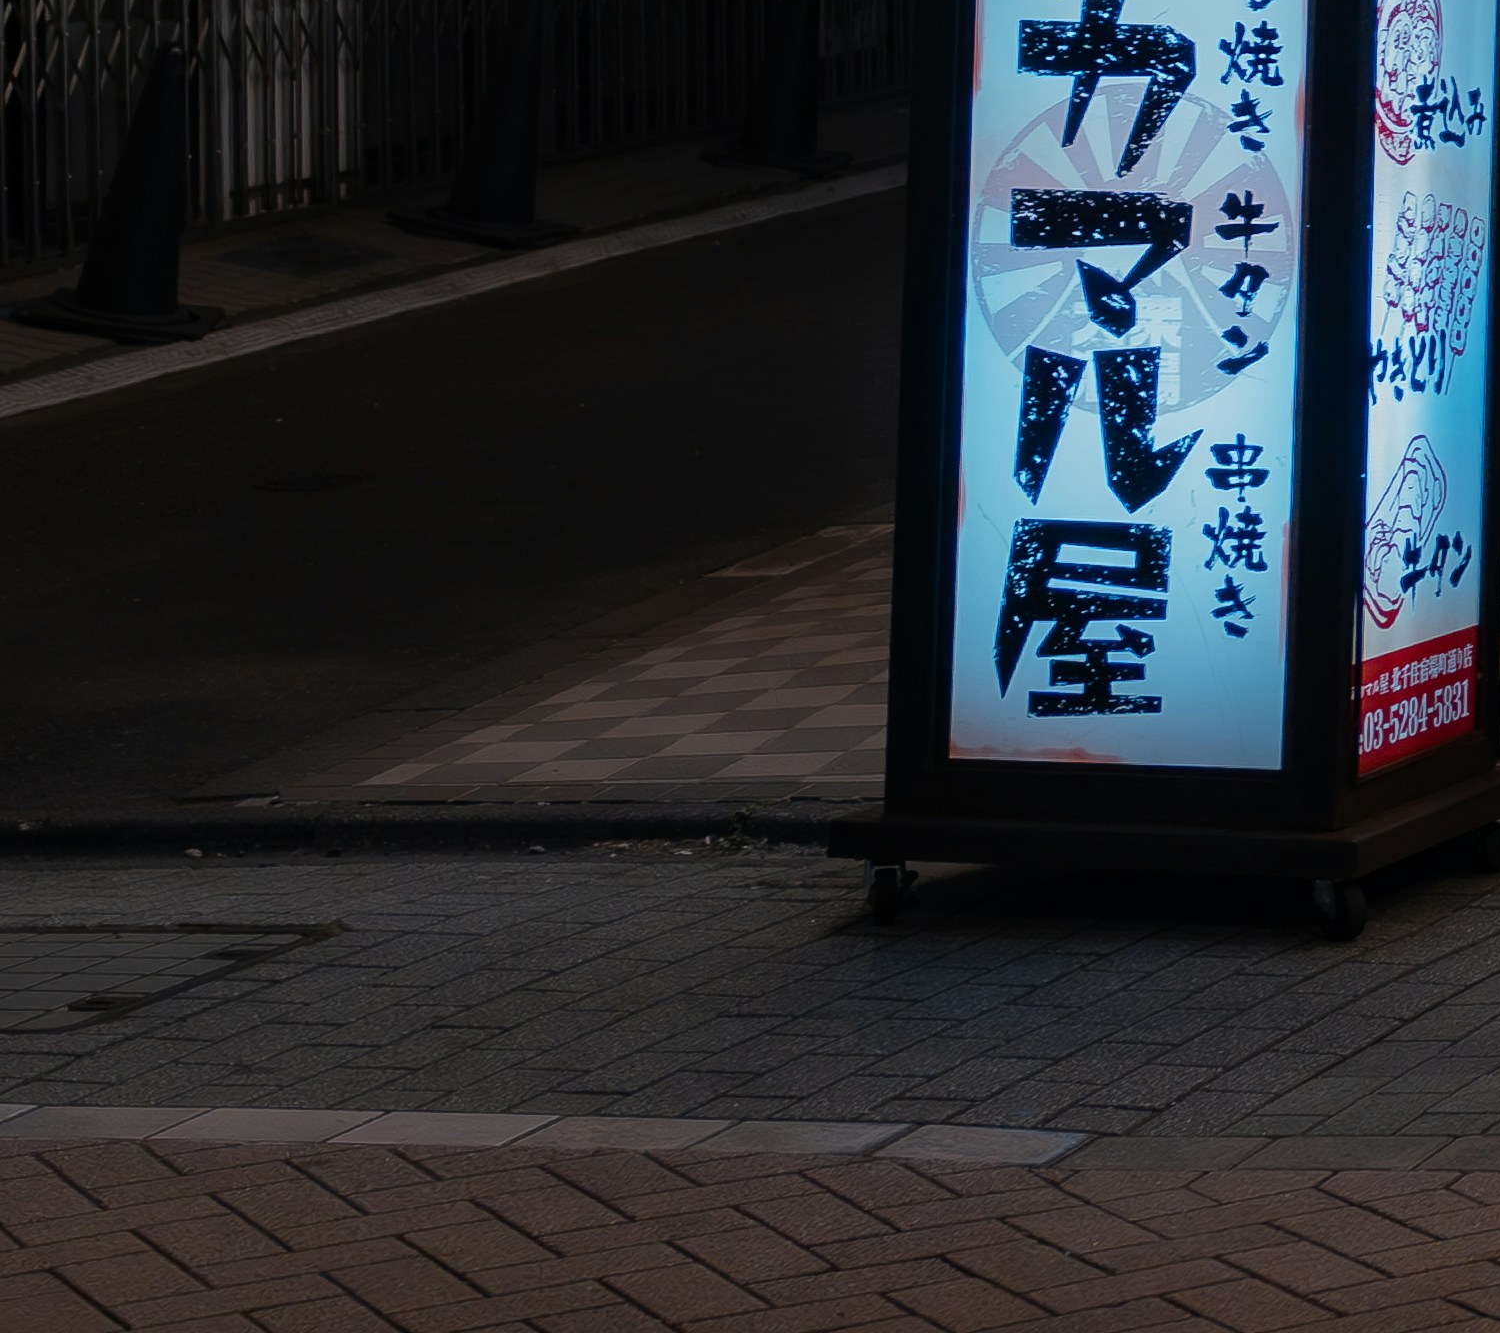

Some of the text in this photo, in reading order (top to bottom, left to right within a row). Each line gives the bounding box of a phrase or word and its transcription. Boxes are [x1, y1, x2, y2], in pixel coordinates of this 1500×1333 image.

[1409, 75, 1488, 151] 煮込み
[1213, 190, 1281, 376] 牛タン
[1202, 433, 1270, 639] 串焼き
[1399, 530, 1473, 611] 牛タン
